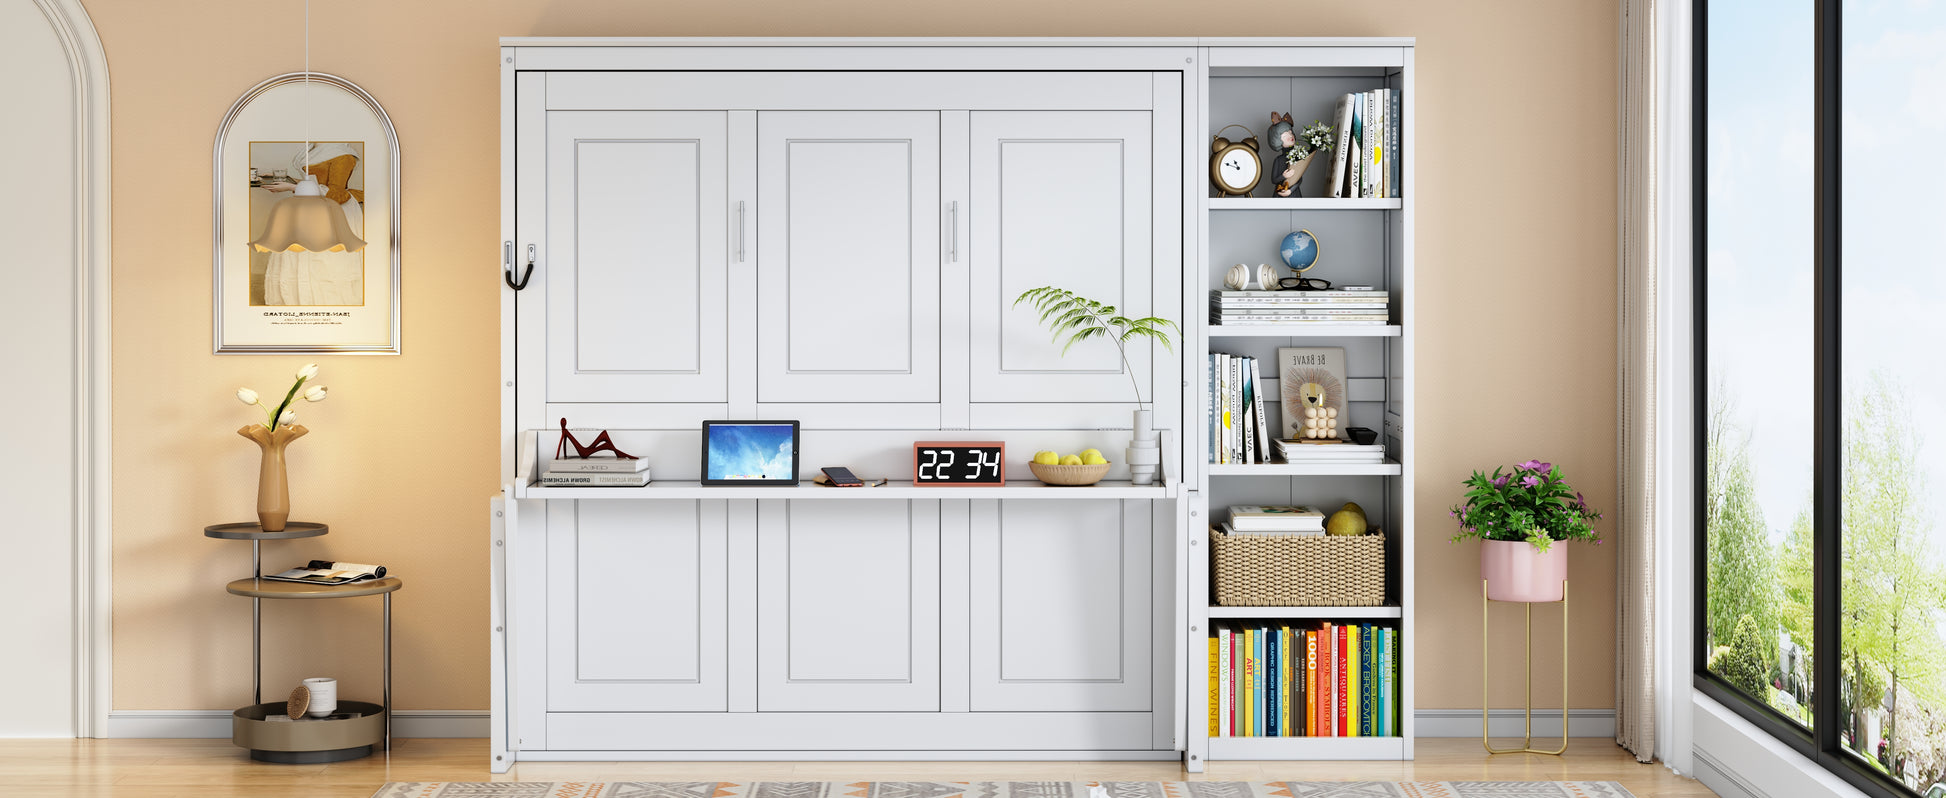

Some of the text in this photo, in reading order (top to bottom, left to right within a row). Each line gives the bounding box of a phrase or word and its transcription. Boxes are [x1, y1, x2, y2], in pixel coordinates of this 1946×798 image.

[919, 450, 1000, 479] 22 34
[1221, 633, 1229, 682] WINDOWS
[1308, 635, 1317, 670] 1000
[1210, 653, 1218, 733] FINE WINES
